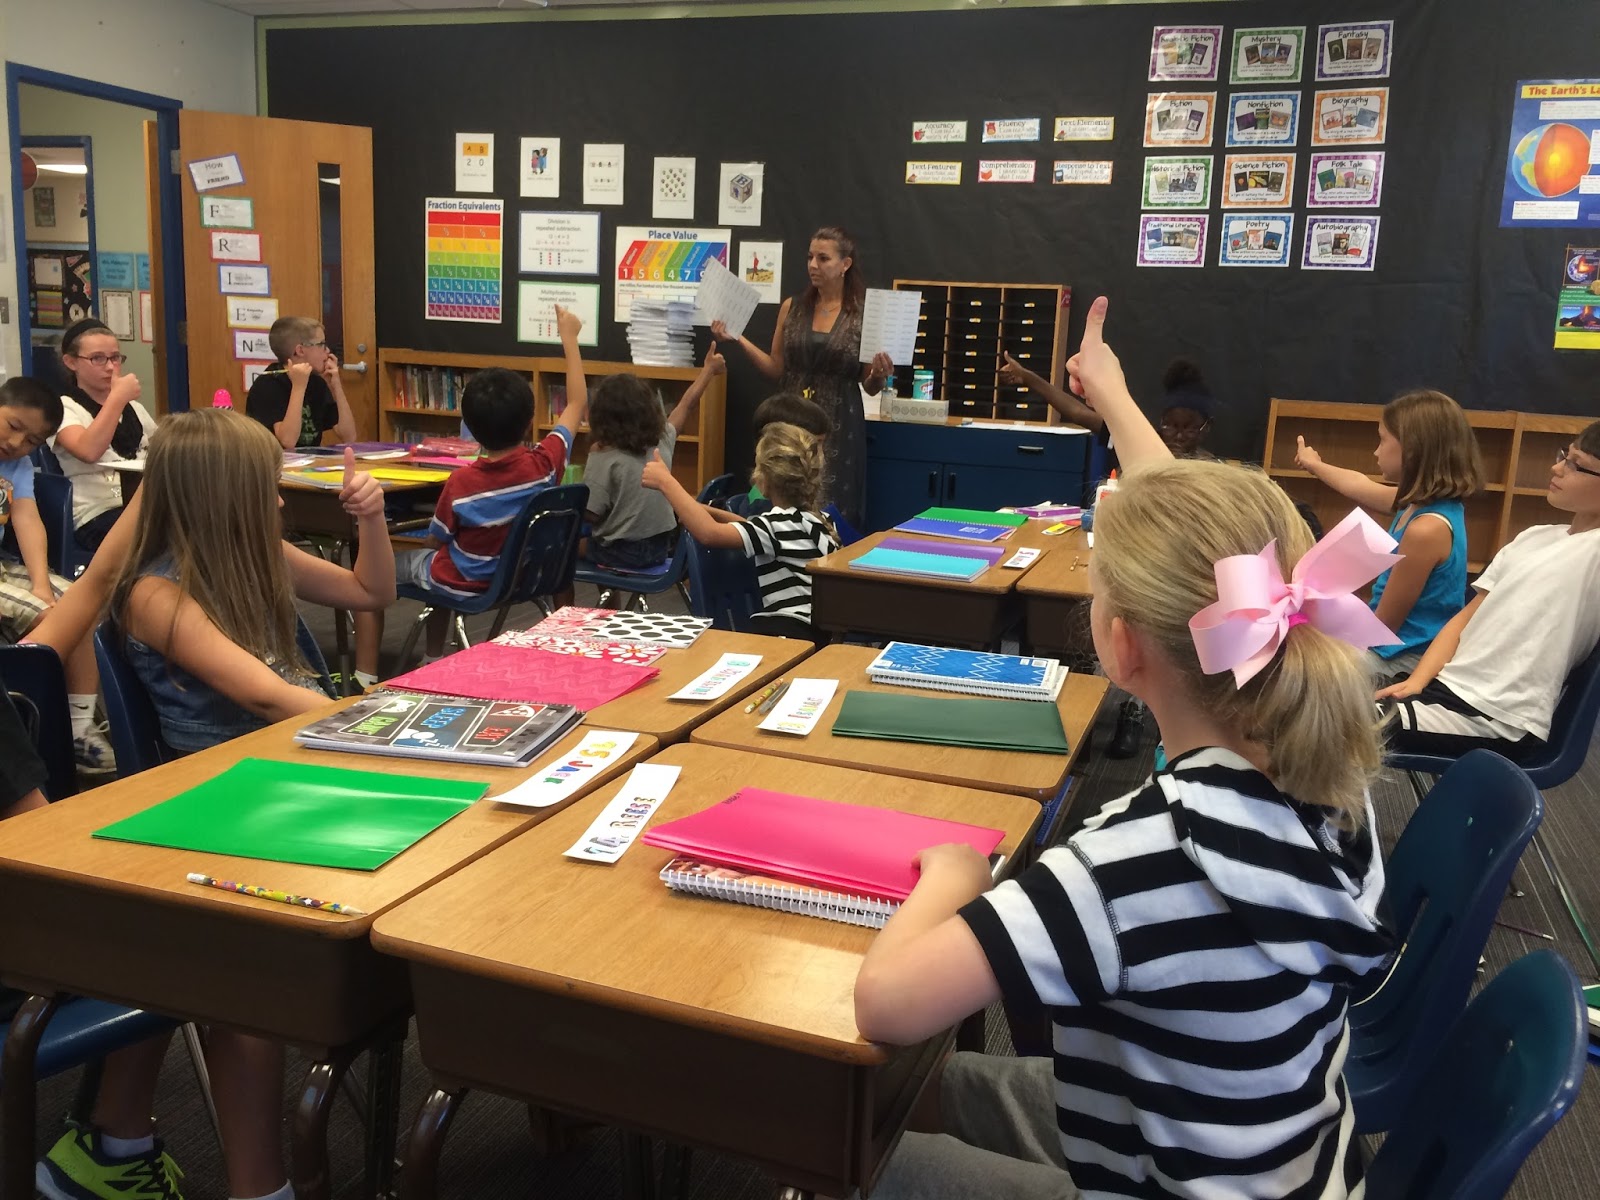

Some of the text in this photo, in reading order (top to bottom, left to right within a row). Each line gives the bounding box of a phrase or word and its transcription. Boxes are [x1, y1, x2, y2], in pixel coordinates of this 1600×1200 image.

[1190, 34, 1214, 42] Fiction
[1251, 34, 1282, 45] Mystery
[1338, 31, 1369, 40] Fantasy
[1529, 87, 1548, 95] The
[1551, 86, 1587, 95] Earth's
[1170, 100, 1193, 108] Fiction
[1247, 101, 1284, 109] Nonfiction
[1332, 95, 1369, 107] Biography
[466, 158, 472, 167] 2
[981, 161, 1033, 169] Comprehension
[1183, 164, 1207, 172] Fiction
[1261, 161, 1286, 169] Fiction
[207, 175, 230, 184] FRIEND
[210, 204, 220, 218] F
[428, 200, 501, 211] Fraction Equivalents
[1245, 219, 1270, 230] Poetry
[1316, 223, 1369, 234] Autobiography
[648, 230, 698, 240] Place Value
[218, 238, 231, 253] R
[623, 268, 628, 279] 1
[638, 269, 645, 280] 5
[653, 269, 660, 280] 6
[668, 269, 675, 280] 4
[684, 270, 691, 281] 7
[236, 307, 247, 321] E
[242, 339, 253, 353] N
[420, 706, 467, 729] SLEEP
[348, 715, 400, 735] GAME
[543, 760, 593, 784] JACK
[609, 796, 657, 828] REESE
